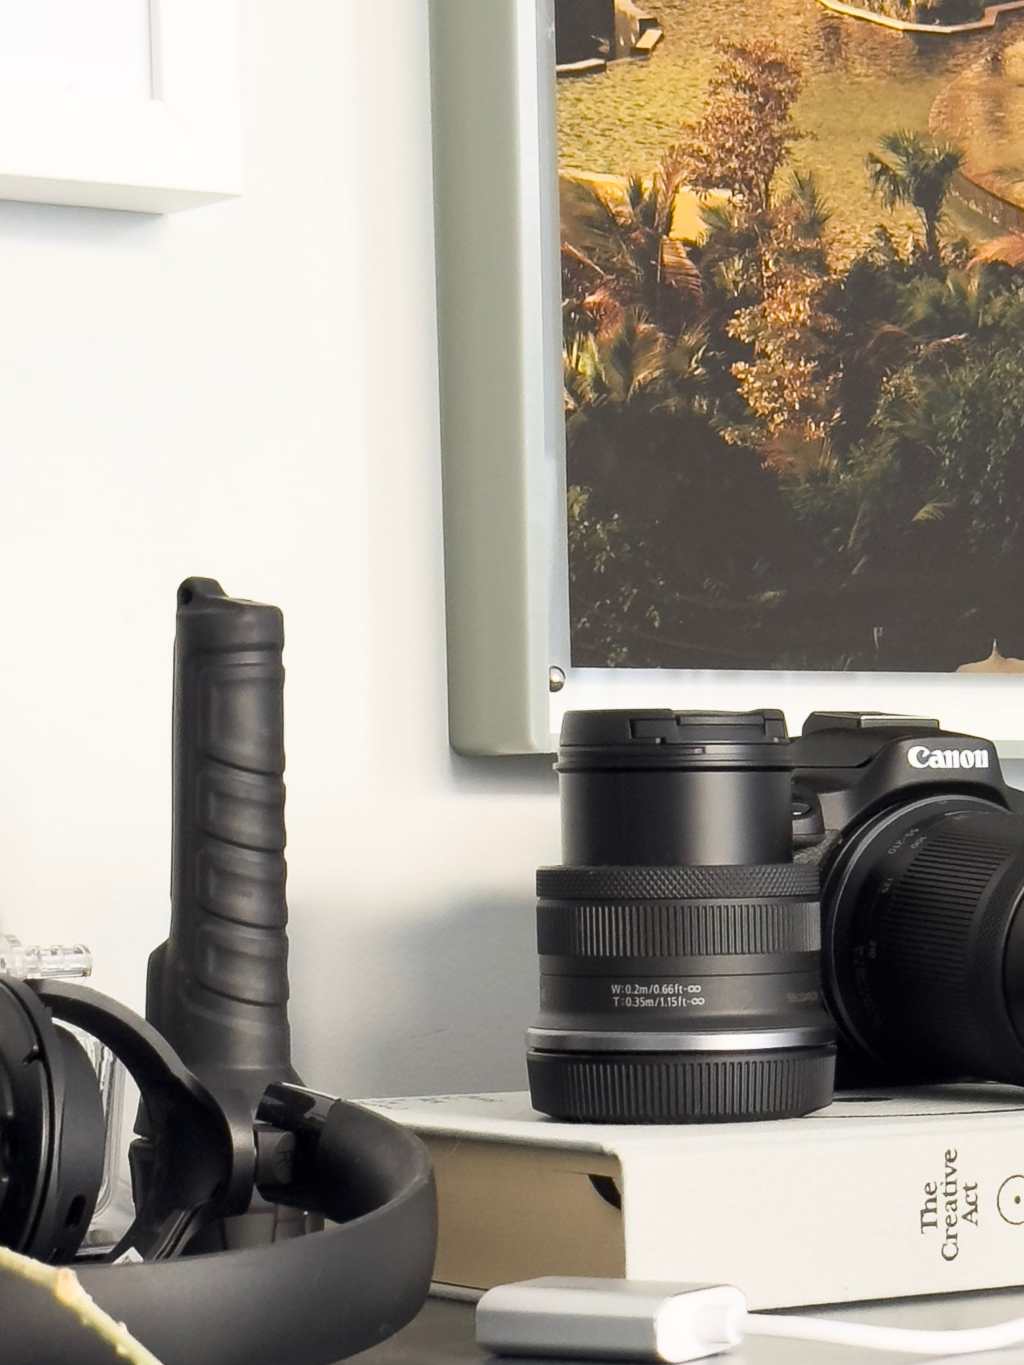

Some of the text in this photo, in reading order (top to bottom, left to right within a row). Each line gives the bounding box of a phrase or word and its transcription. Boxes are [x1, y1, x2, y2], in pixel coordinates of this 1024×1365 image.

[907, 745, 989, 769] Canon
[920, 1181, 938, 1235] The
[941, 1148, 959, 1262] Creative
[961, 1182, 979, 1227] Act
